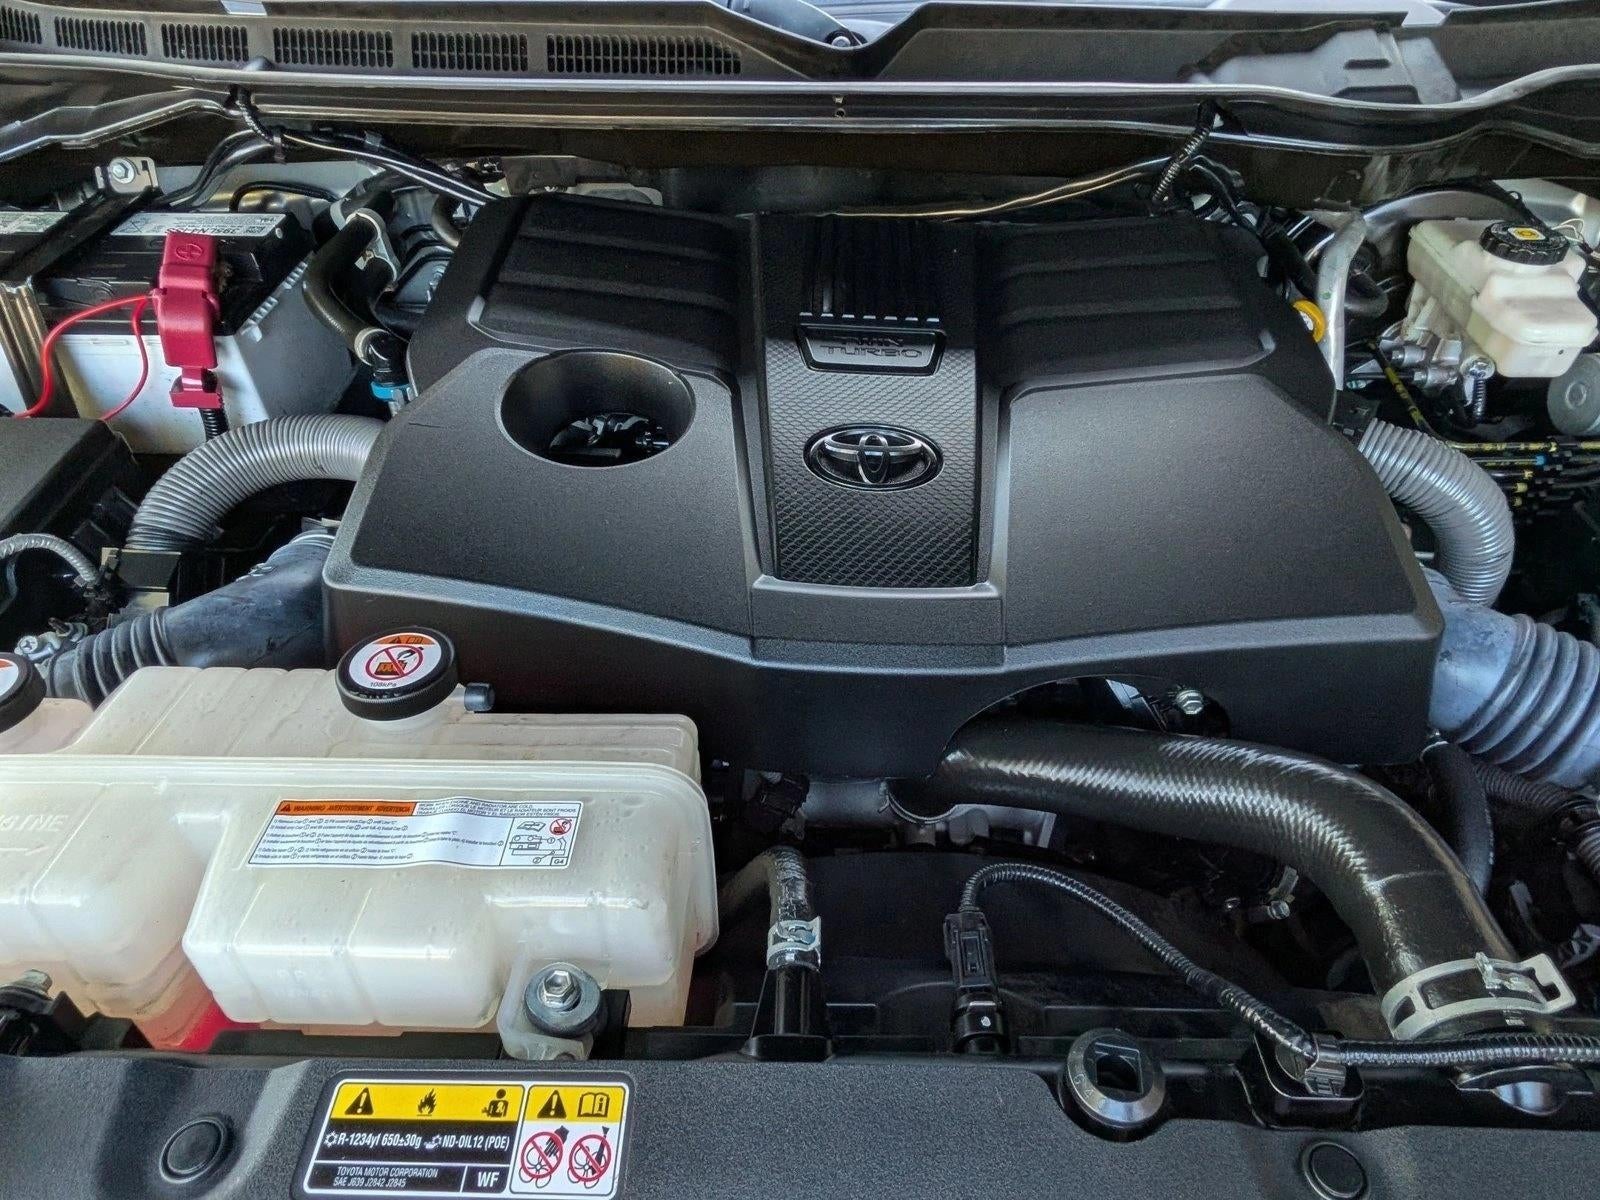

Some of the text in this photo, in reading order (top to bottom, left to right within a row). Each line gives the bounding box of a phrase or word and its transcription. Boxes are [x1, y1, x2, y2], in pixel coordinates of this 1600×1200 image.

[818, 345, 923, 358] TURBO
[293, 804, 326, 812] WARNING
[336, 1132, 382, 1149] R-1234yf
[381, 1133, 422, 1149] 650±30g
[484, 1135, 511, 1152] (POE)
[337, 1165, 439, 1178] TOYOTA MOTOR CORPORATION
[332, 1176, 407, 1188] SAE J639 J2842 J2845
[477, 1170, 500, 1188] WF
